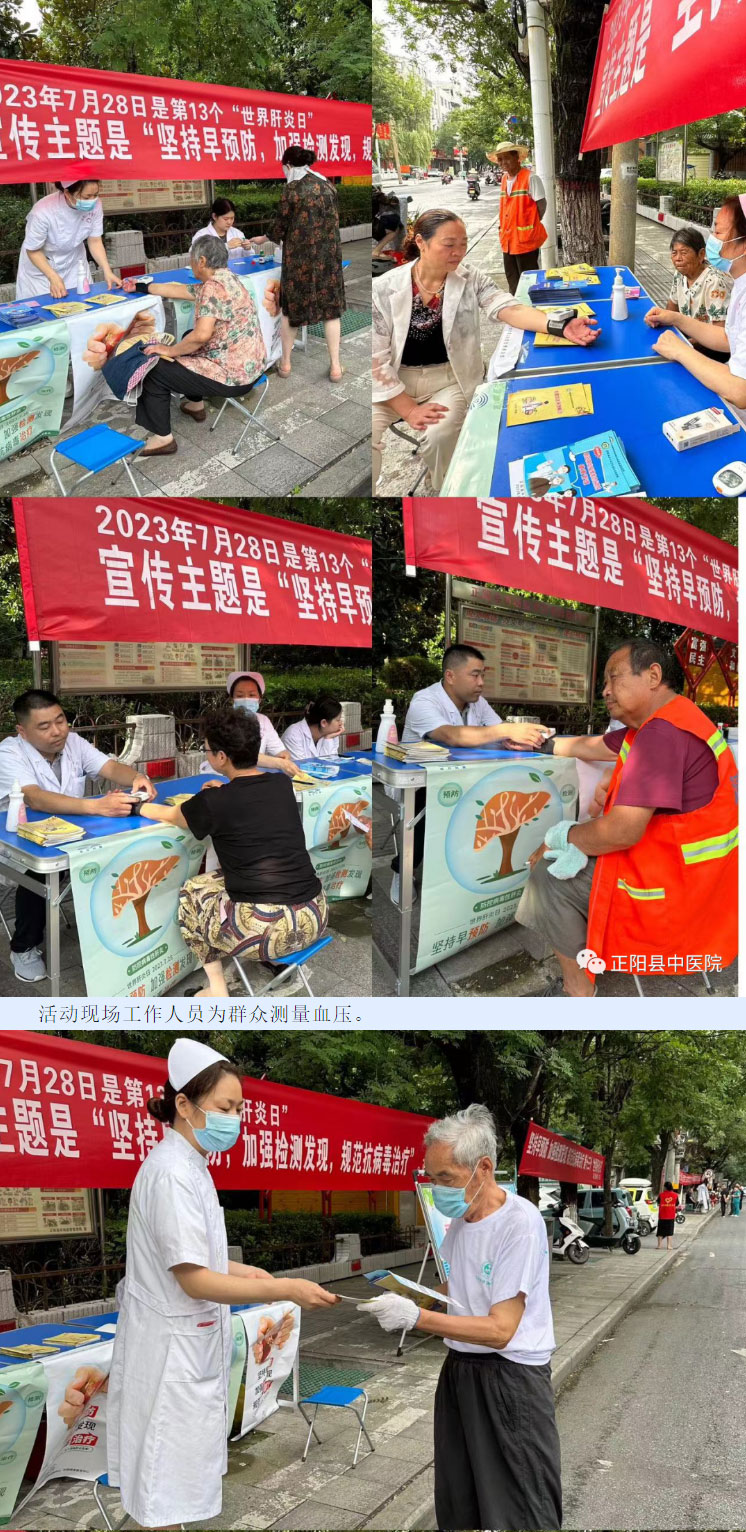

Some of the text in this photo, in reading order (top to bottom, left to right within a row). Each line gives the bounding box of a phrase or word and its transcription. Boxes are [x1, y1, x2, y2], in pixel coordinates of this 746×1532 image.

[0, 84, 313, 129] 23年7月28日是第13个“世界肝炎日”
